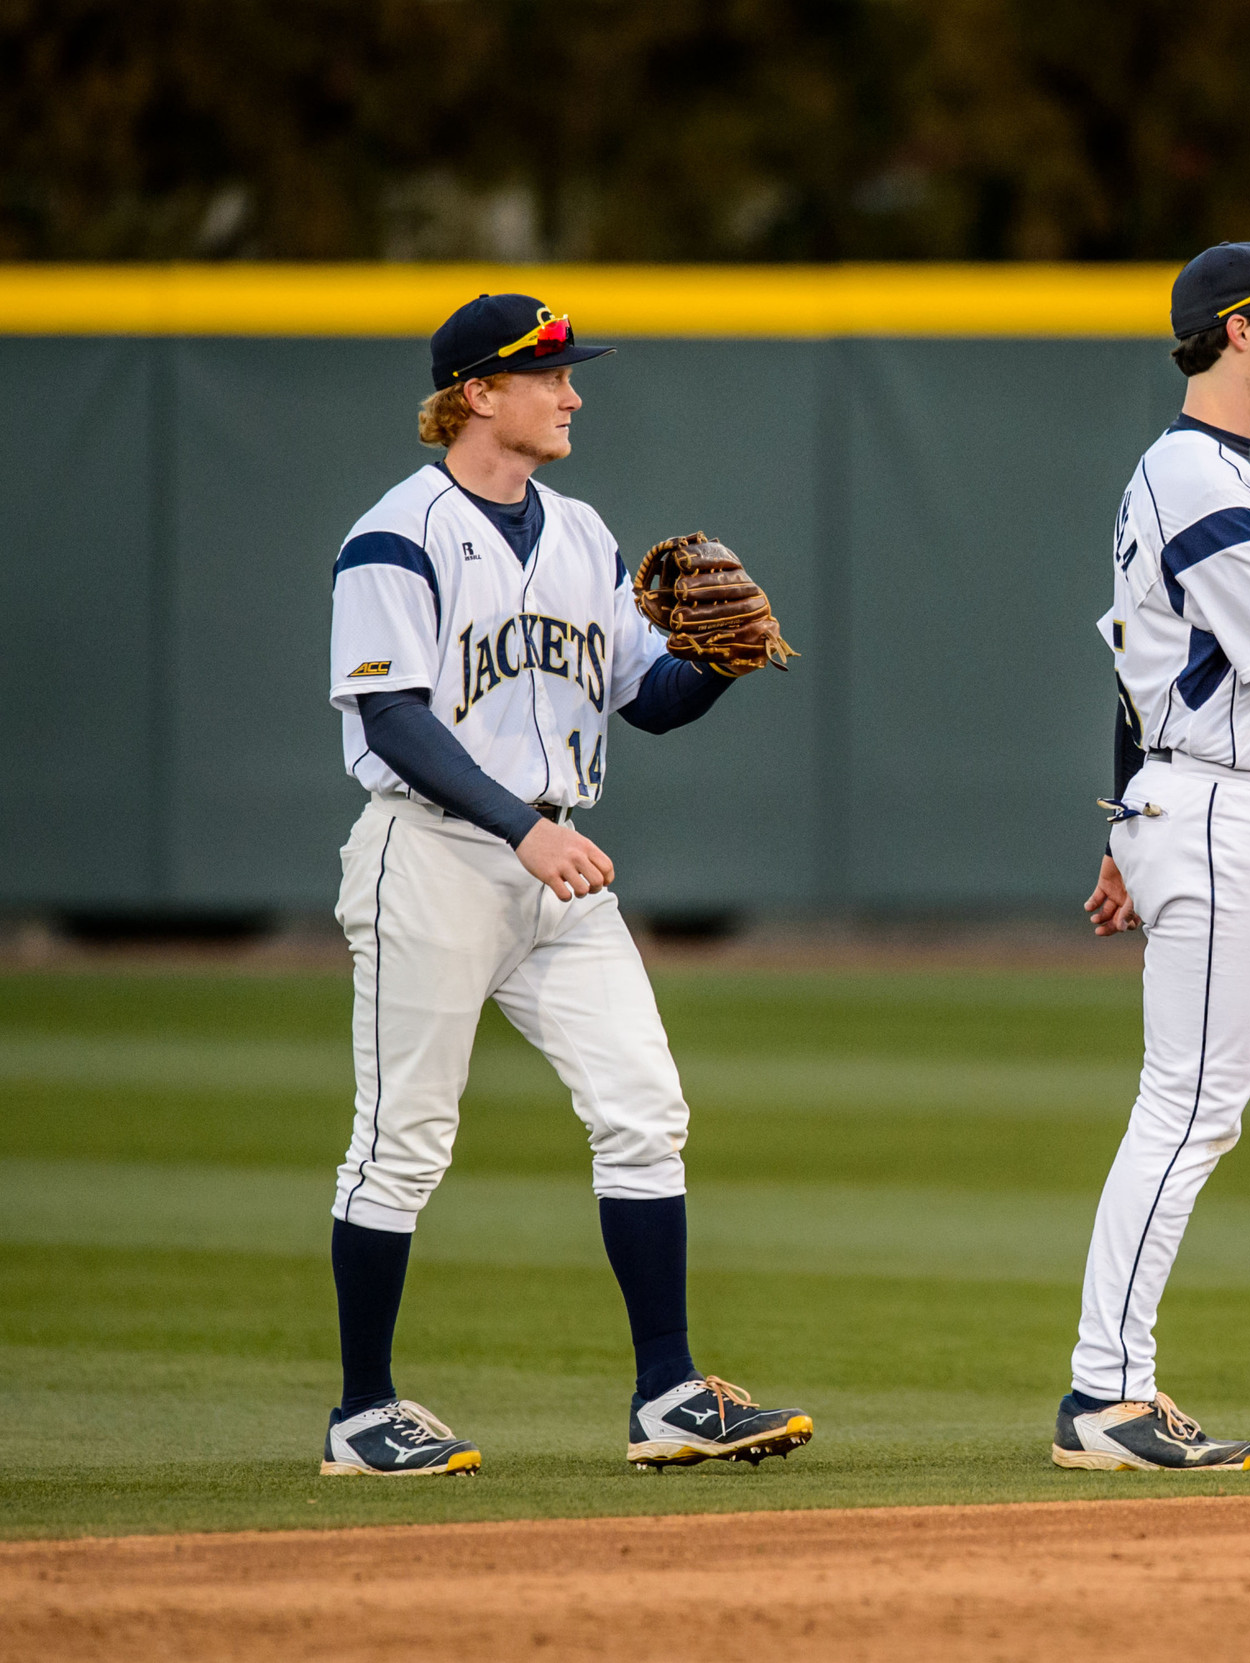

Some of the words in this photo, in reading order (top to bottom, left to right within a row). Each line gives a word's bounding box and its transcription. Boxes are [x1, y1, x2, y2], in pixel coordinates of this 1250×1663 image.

[461, 541, 474, 556] R
[350, 661, 391, 677] ACC
[453, 612, 606, 727] JACKETS
[566, 728, 602, 804] 14
